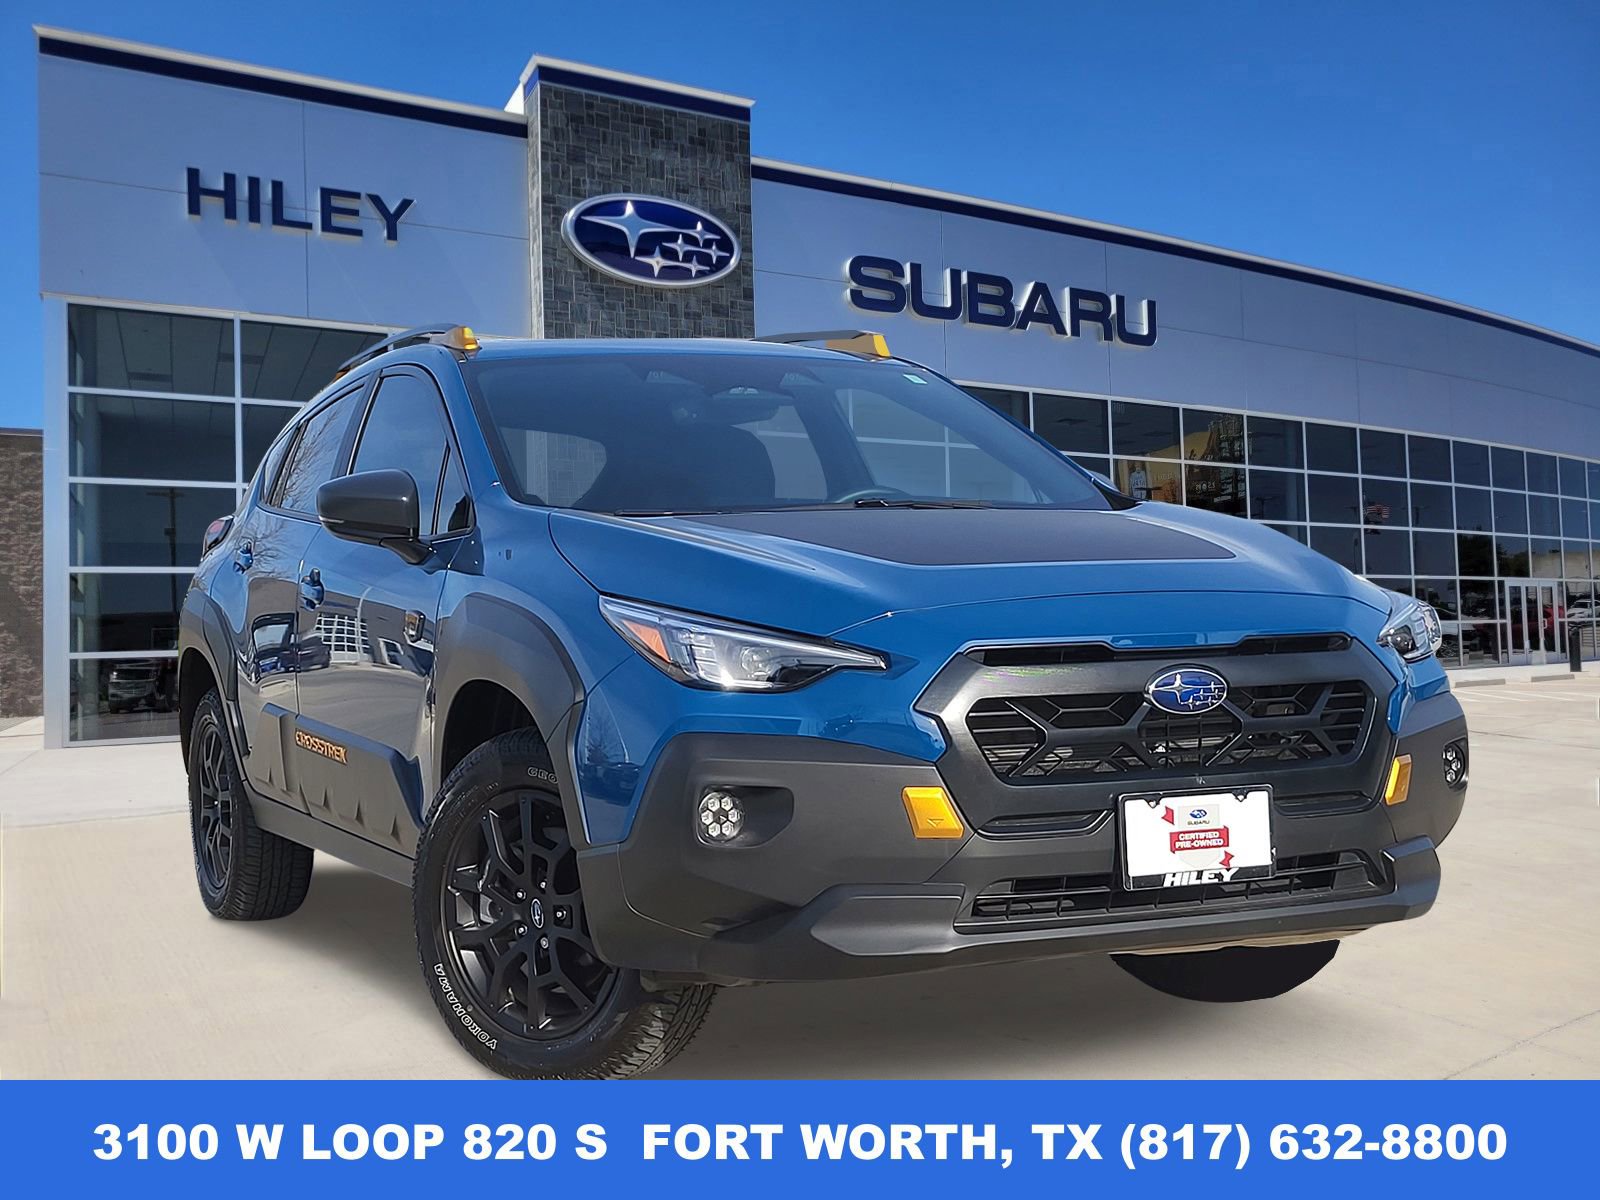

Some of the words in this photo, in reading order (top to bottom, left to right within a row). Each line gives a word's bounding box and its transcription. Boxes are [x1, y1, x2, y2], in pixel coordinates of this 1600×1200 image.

[187, 167, 415, 241] HILEY
[849, 255, 1158, 347] SUBARU
[295, 730, 348, 764] CROSSTREK
[1175, 838, 1224, 849] PRE-OWNED
[1178, 831, 1220, 841] CERTIFIED
[1163, 867, 1240, 888] HILEY
[434, 963, 498, 1050] YOKOHAMA
